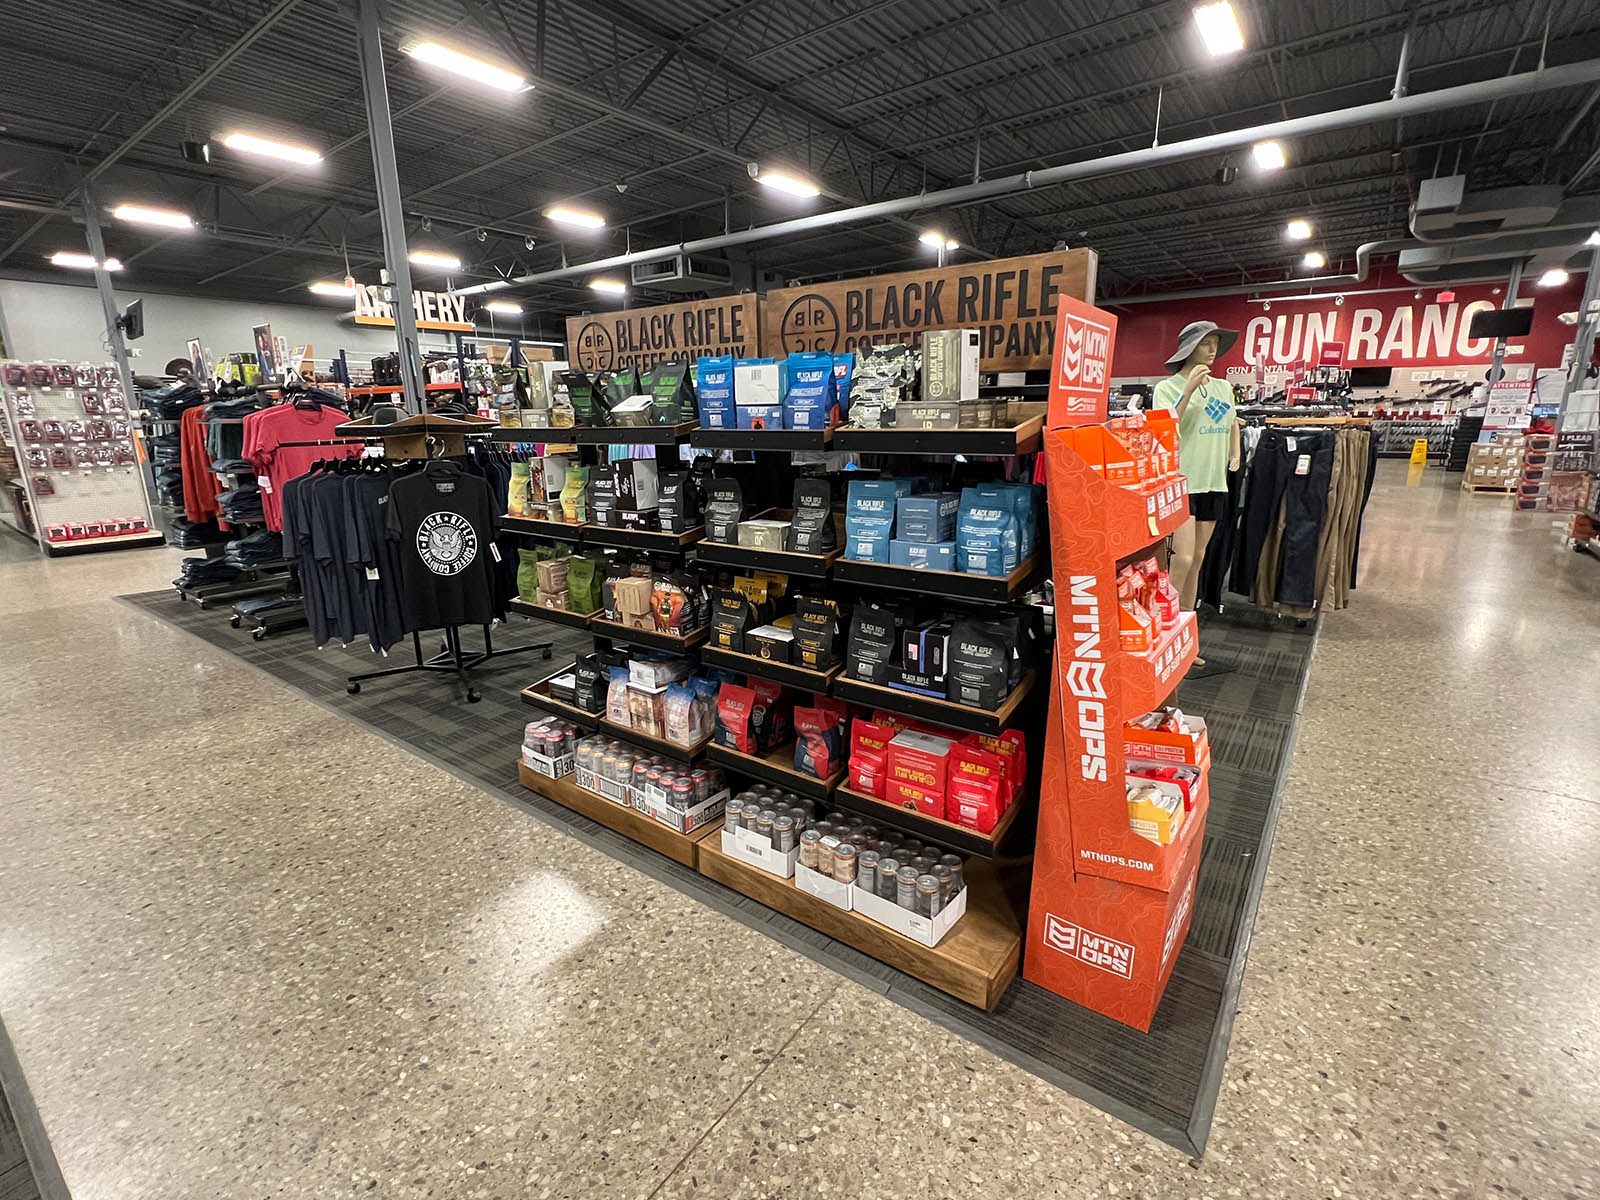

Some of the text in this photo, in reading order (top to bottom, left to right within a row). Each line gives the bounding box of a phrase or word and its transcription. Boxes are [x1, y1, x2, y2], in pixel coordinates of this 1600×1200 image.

[355, 283, 465, 323] AHERY
[846, 265, 1063, 333] BLACK RIFLE
[615, 304, 744, 353] BLACK RIFLE
[1243, 311, 1337, 365] GUN
[1086, 330, 1107, 359] MTN
[1082, 358, 1105, 385] OPS
[1226, 366, 1249, 374] GUN
[419, 514, 442, 542] BLACK
[450, 516, 475, 540] RIFLE
[452, 547, 474, 572] COFFEE
[960, 643, 978, 651] BLACK
[978, 646, 992, 655] RIFLE
[902, 672, 929, 684] BLACK RIFLE
[1070, 576, 1108, 782] MTN OPS
[1080, 850, 1154, 872] MTNOPS.COM
[1082, 933, 1129, 959] MTN
[1081, 947, 1127, 974] OPS
